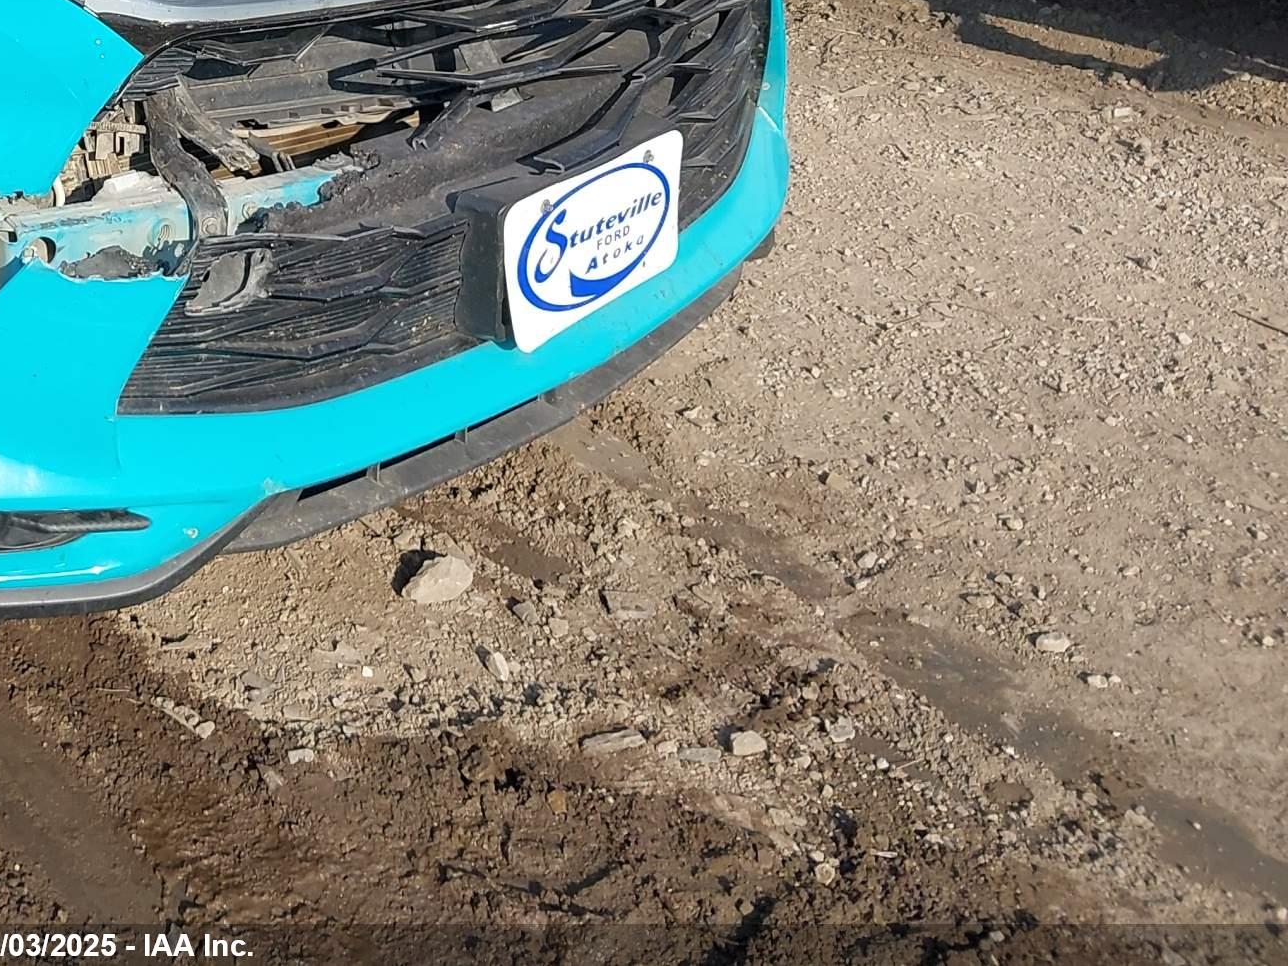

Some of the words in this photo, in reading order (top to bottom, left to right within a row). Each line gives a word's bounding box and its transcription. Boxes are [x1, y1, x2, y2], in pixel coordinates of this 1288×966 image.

[534, 190, 663, 284] Stuteville
[585, 234, 645, 275] Atoka
[596, 224, 631, 251] FORD
